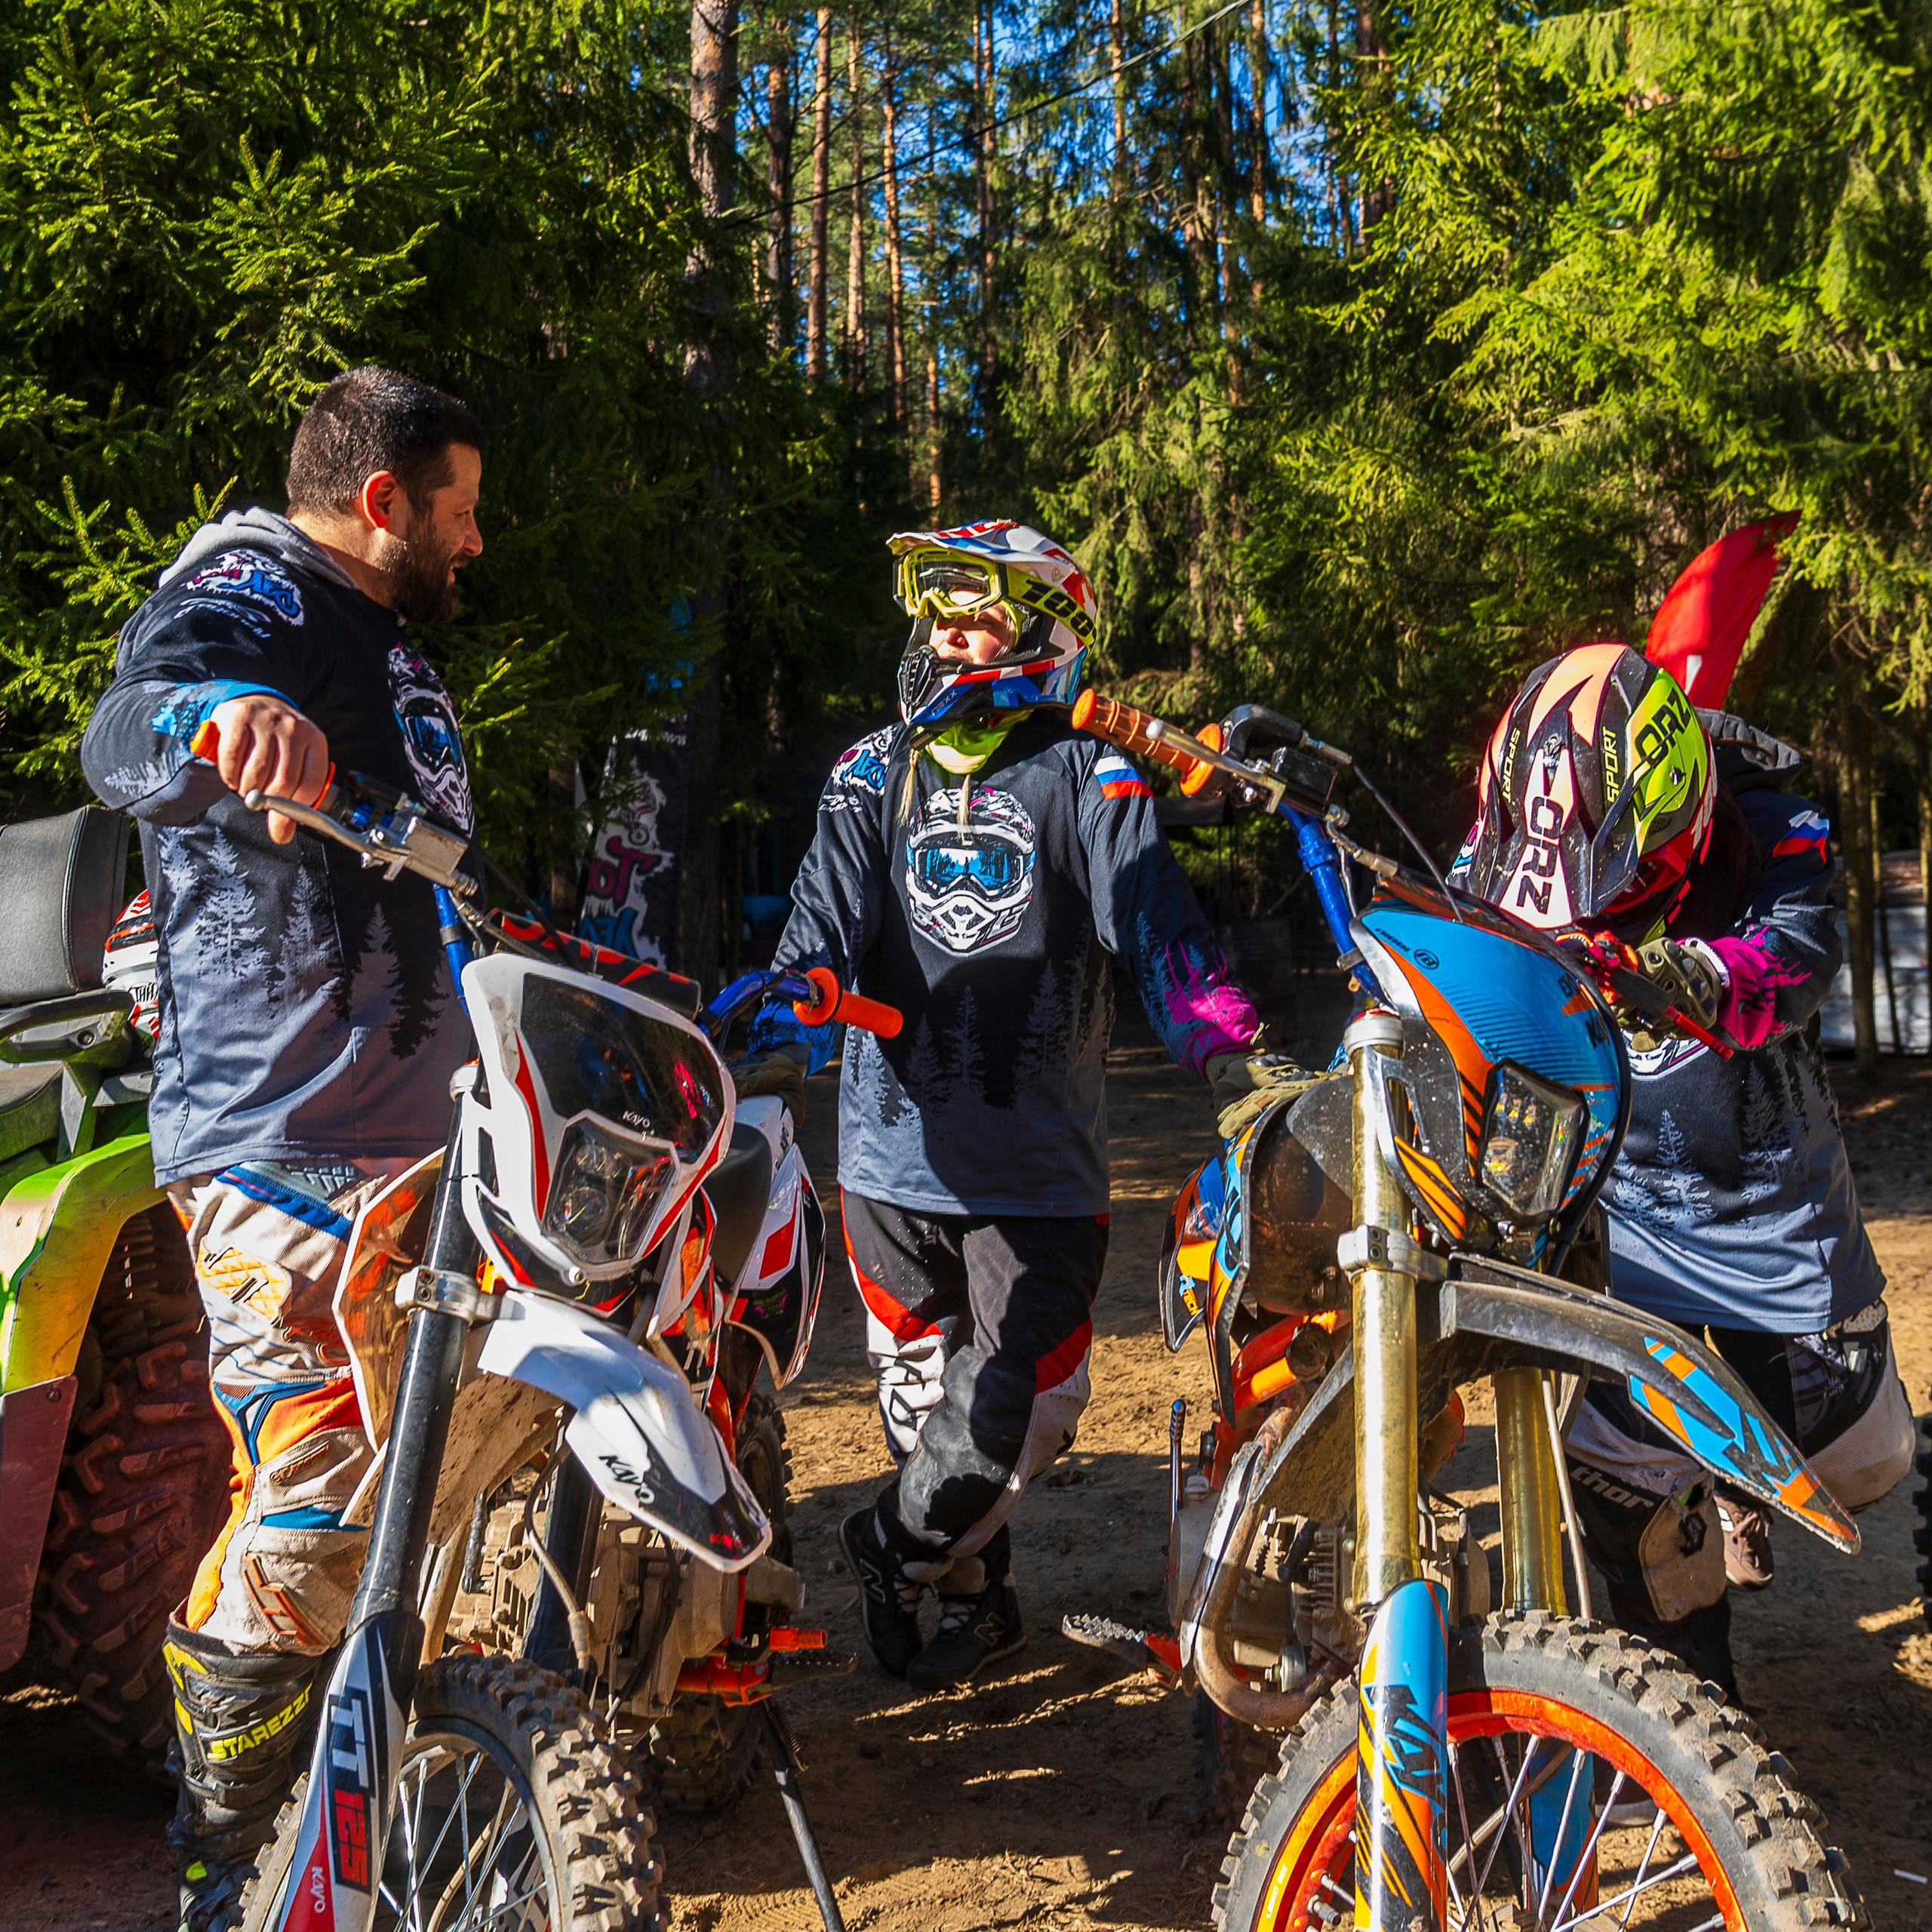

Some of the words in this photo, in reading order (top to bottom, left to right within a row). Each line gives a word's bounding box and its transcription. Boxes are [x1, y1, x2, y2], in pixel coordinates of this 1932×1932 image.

[1603, 727, 1619, 803] SPORT
[1635, 687, 1691, 768] ORZ
[1503, 728, 1520, 803] SPORT
[1516, 796, 1564, 915] ORZ
[622, 1110, 651, 1128] KAYO
[598, 1455, 655, 1504] KAYO
[1571, 1466, 1654, 1508] thor
[335, 1789, 368, 1885] 125
[311, 1866, 325, 1913] KAYO
